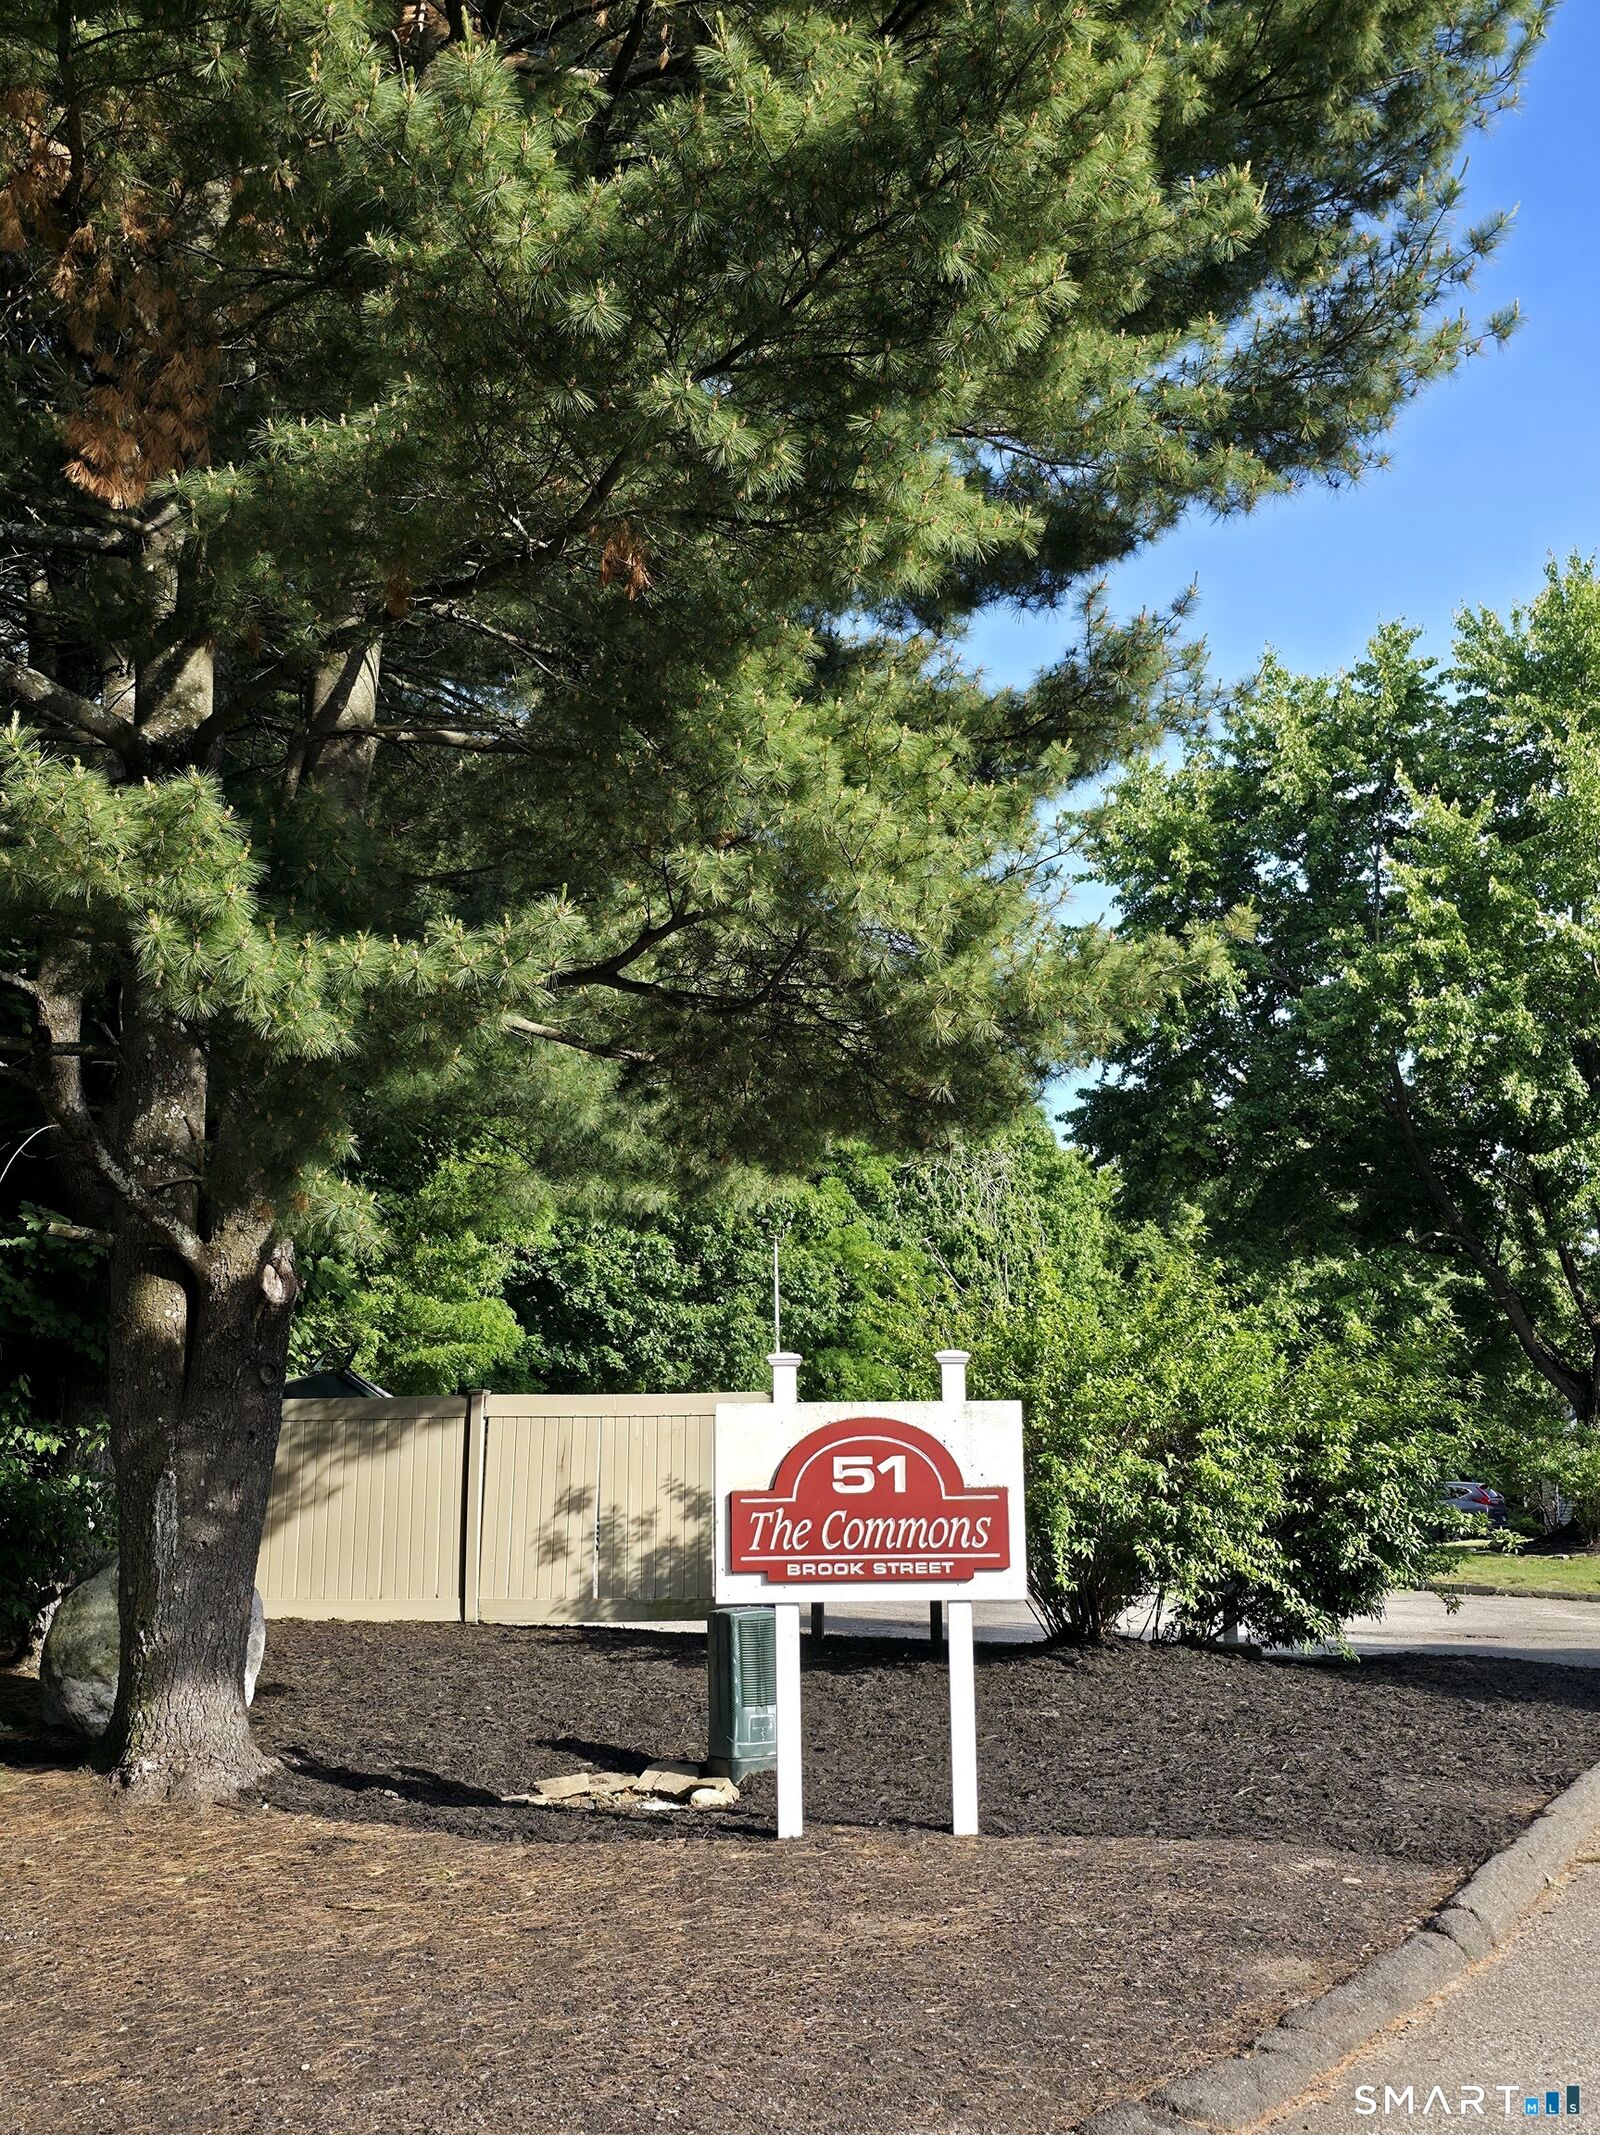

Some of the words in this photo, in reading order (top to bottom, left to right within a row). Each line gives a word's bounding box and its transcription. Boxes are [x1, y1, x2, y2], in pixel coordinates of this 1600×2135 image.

[832, 1455, 907, 1494] 51
[749, 1507, 813, 1551] The
[822, 1508, 992, 1551] Commons
[786, 1561, 865, 1576] BROOK
[873, 1561, 955, 1575] STREET
